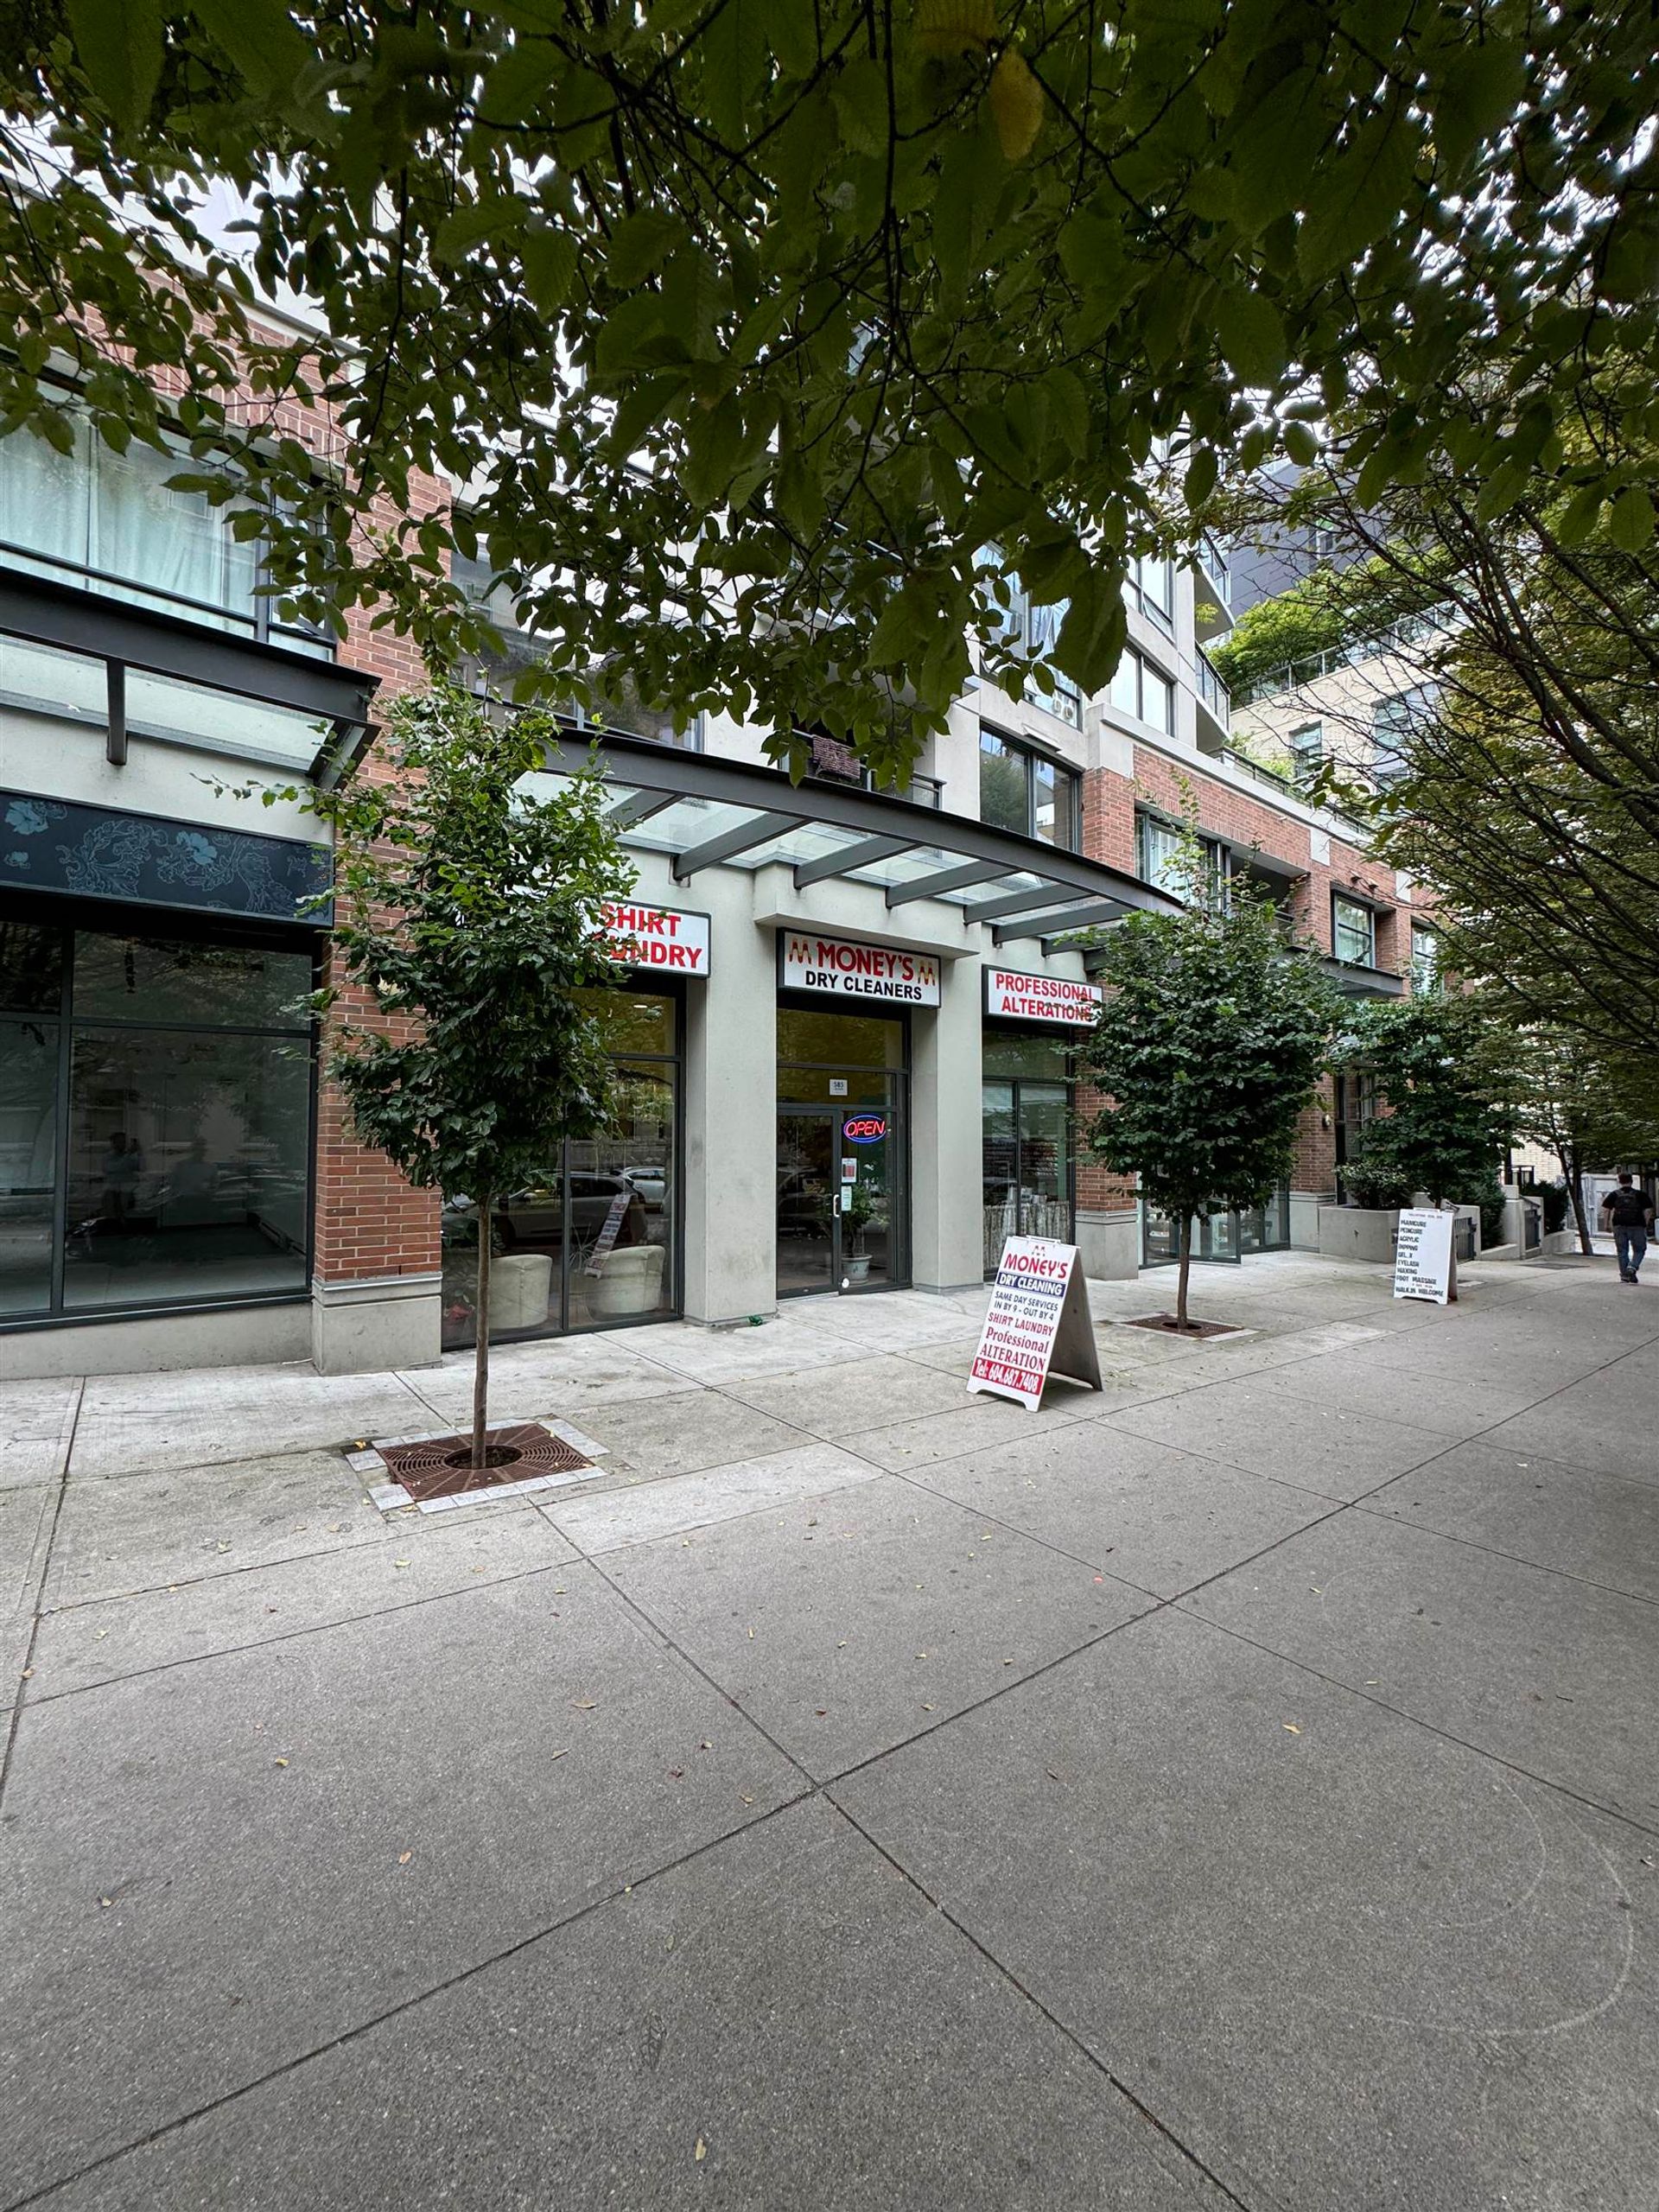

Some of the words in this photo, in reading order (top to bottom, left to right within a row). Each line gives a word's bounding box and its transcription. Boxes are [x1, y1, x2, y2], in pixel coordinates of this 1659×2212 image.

[601, 903, 682, 937] SHIRT
[591, 931, 702, 969] UNDRY
[816, 940, 914, 982] MONEY'S
[805, 970, 839, 988] DRY
[843, 976, 922, 1001] CLEANERS
[995, 973, 1093, 1001] PROFESSIONAL
[846, 1121, 886, 1136] OPEN
[1003, 1253, 1068, 1279] MONEY'S
[999, 1273, 1018, 1287] DRY
[1017, 1278, 1063, 1295] CLEANING
[994, 1300, 1002, 1309] IN
[1003, 1302, 1014, 1312] BY
[1023, 1306, 1039, 1318] OUT
[1039, 1310, 1049, 1320] BY
[995, 1291, 1013, 1302] SAME
[1013, 1294, 1027, 1305] DAY
[1028, 1297, 1058, 1312] SERVICES
[988, 1312, 1014, 1327] SHIRT
[1014, 1318, 1055, 1337] LAUNDRY
[985, 1326, 1050, 1354] Professional
[980, 1343, 1046, 1372] ALTERATION
[975, 1358, 989, 1377] Tel:
[988, 1363, 1039, 1394] 604.687.7408
